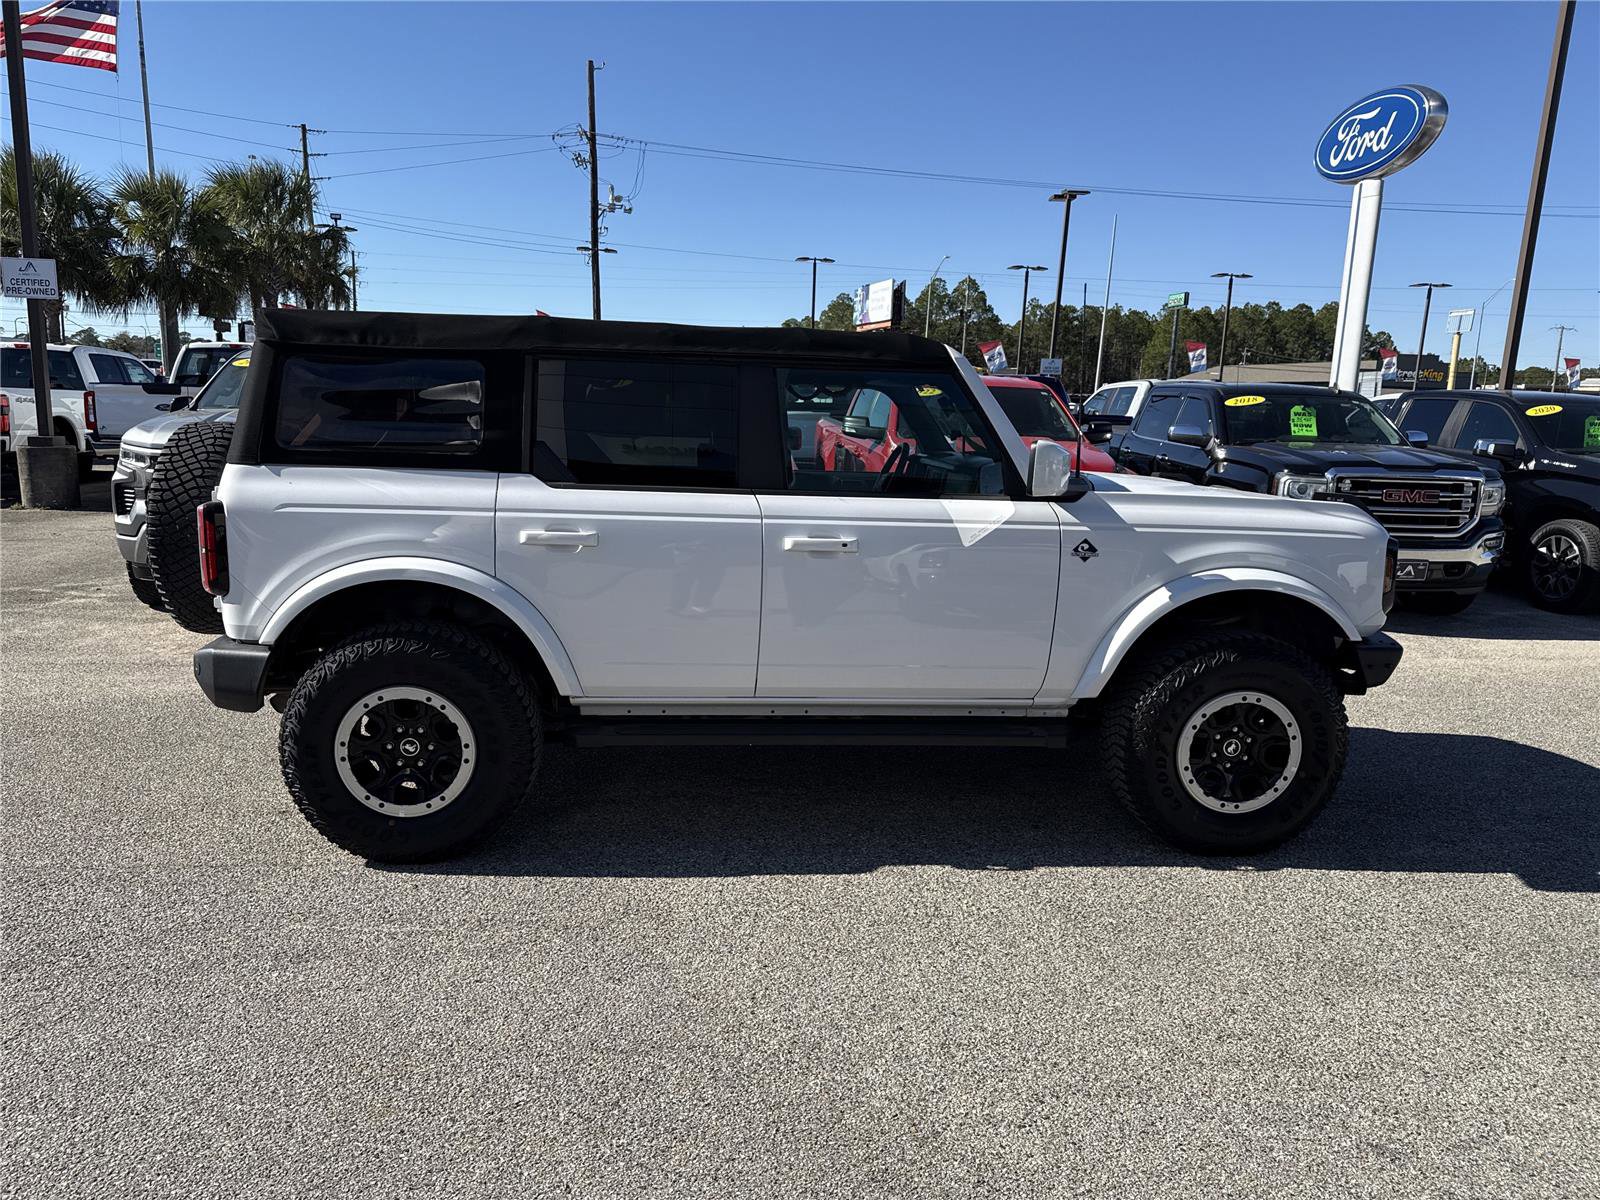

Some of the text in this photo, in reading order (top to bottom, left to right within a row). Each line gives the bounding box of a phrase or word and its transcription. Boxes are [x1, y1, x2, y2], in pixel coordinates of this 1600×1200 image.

[1330, 106, 1398, 167] Ford
[10, 277, 51, 287] CERTIFIED
[6, 286, 56, 296] PRE-OWNED
[1233, 397, 1258, 405] 2018
[1534, 405, 1556, 415] 2020
[1382, 488, 1441, 503] GMC
